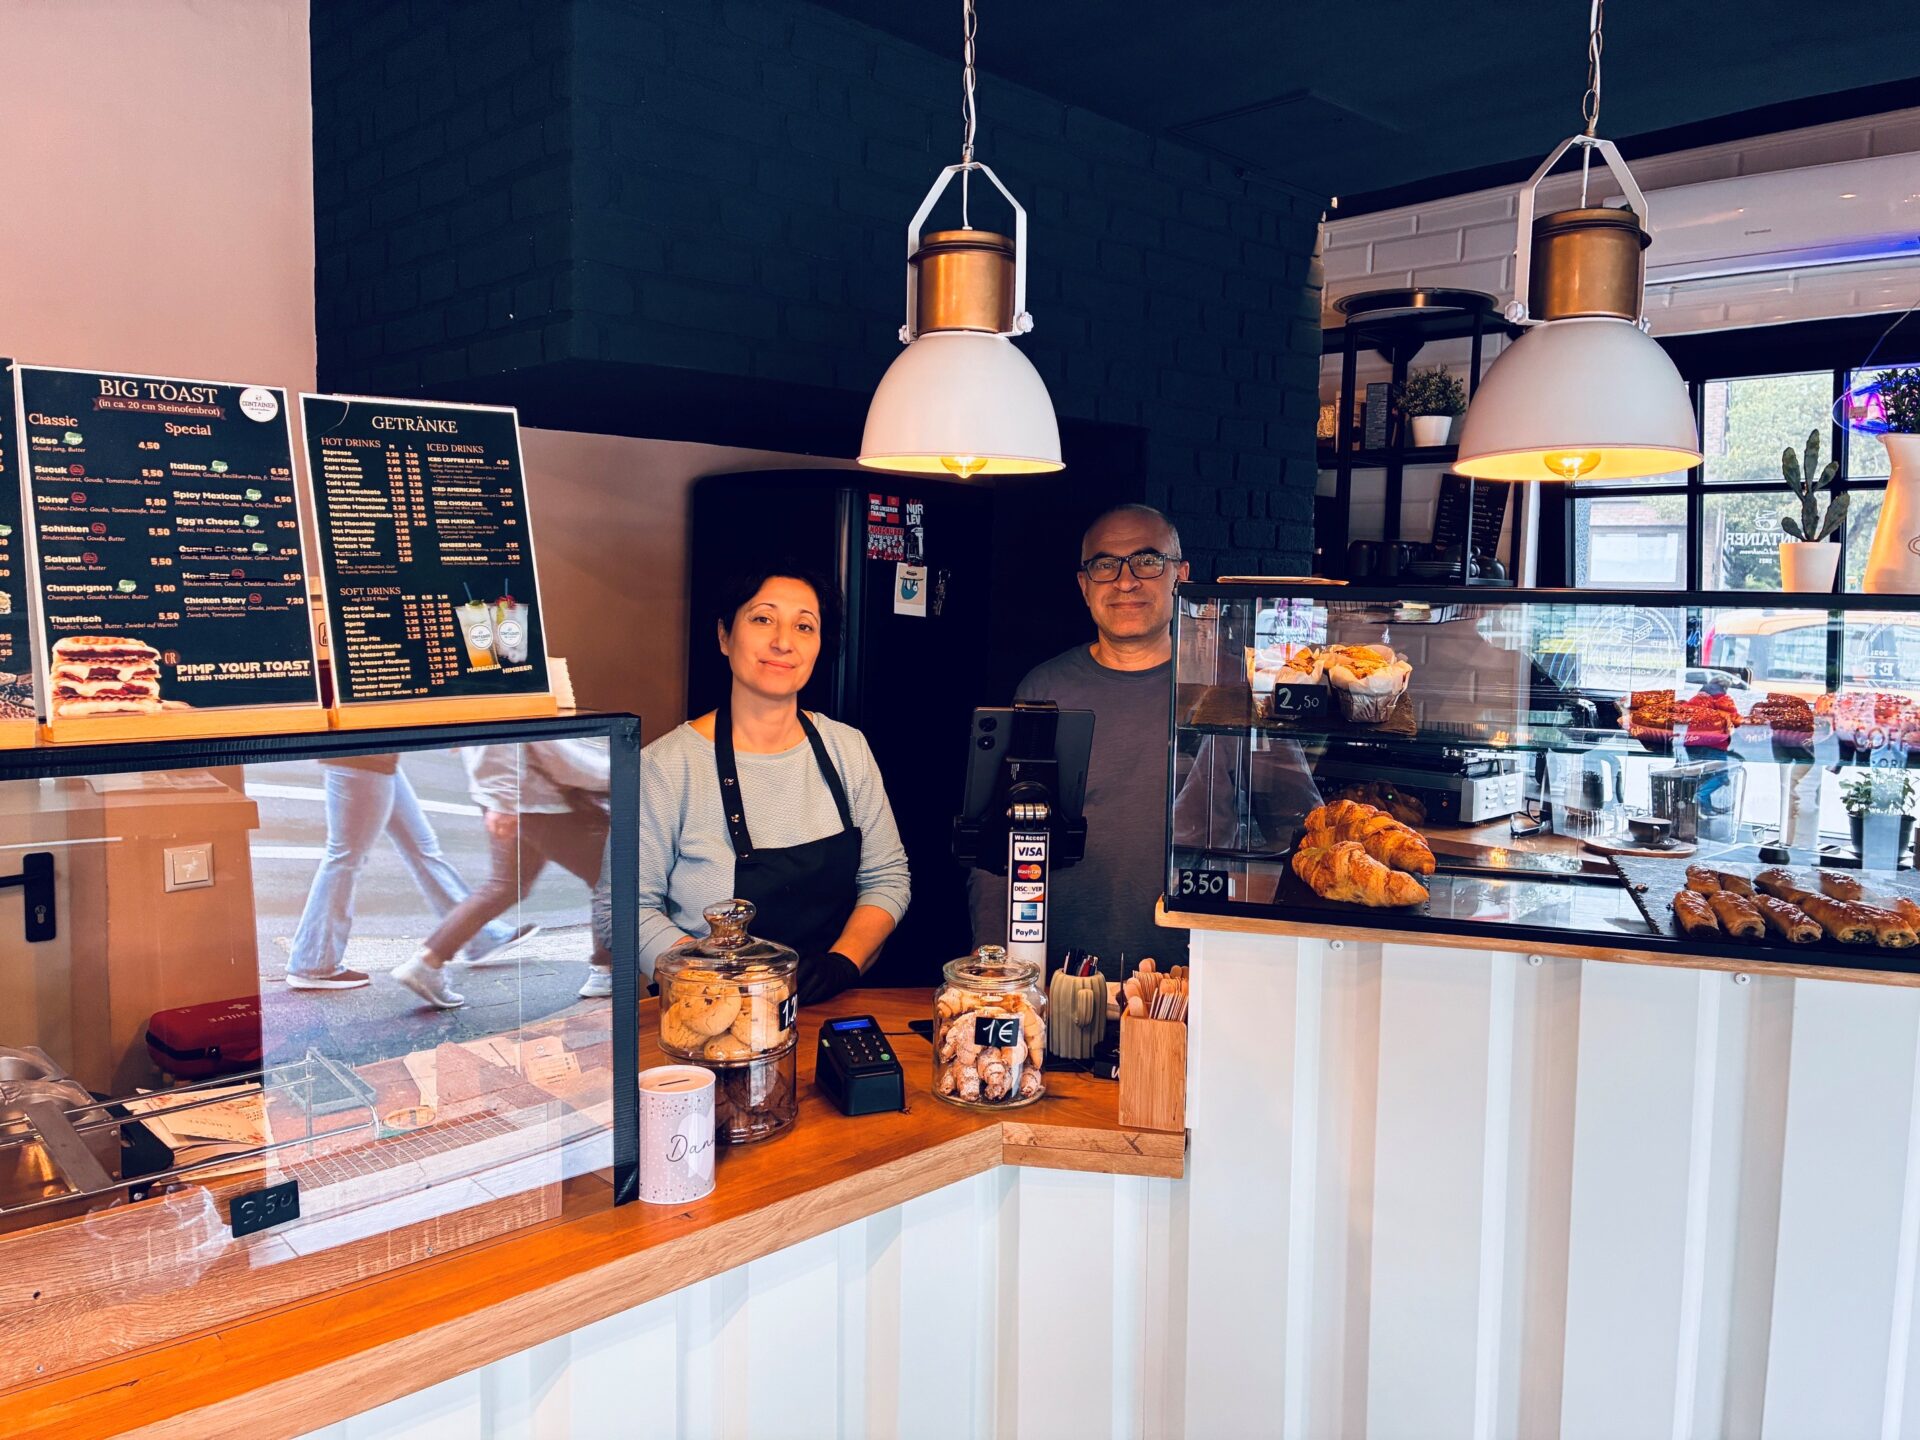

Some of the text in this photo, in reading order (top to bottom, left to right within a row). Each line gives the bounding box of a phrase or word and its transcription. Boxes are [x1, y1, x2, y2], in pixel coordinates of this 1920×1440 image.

[99, 379, 218, 404] BIG TOAST
[98, 399, 110, 408] (in
[142, 402, 156, 410] cm
[158, 403, 220, 417] Steinofenbrot)
[28, 413, 78, 427] Classic
[372, 416, 458, 433] GETRÄNKE
[165, 422, 212, 436] Special
[32, 436, 58, 445] Käse
[321, 437, 381, 448] HOT DRINKS
[138, 442, 160, 450] 4,50
[426, 443, 484, 454] ICED DRINKS
[34, 465, 68, 474] Sucuk
[170, 462, 207, 470] Italiano
[142, 469, 164, 478] 5,50
[325, 472, 363, 480] Cappuccino
[173, 490, 242, 500] Spicy Mexican
[38, 496, 68, 504] Döner
[145, 498, 167, 507] 5,80
[906, 504, 924, 514] NUR
[206, 518, 240, 526] Cheese
[906, 514, 921, 525] LEV
[40, 525, 90, 533] Schinken
[277, 521, 296, 529] 6,50
[148, 528, 170, 536] 5,50
[280, 548, 298, 556] 6,50
[150, 558, 172, 566] 5,50
[46, 584, 113, 593] Champignon
[154, 584, 176, 593] 5,00
[340, 586, 401, 596] SOFT DRINKS
[222, 597, 246, 605] Story
[286, 597, 304, 606] 7,20
[158, 612, 180, 621] 5,50
[176, 660, 310, 674] PIMP YOUR TOAST
[502, 665, 532, 674] HIMBEER
[1279, 687, 1320, 710] 2,50
[1018, 847, 1043, 856] VISA
[1183, 871, 1224, 894] 3,50
[1016, 928, 1040, 937] PayPal
[983, 1019, 1014, 1044] 1€
[666, 1134, 714, 1162] Dan
[241, 1192, 293, 1225] 3,50
